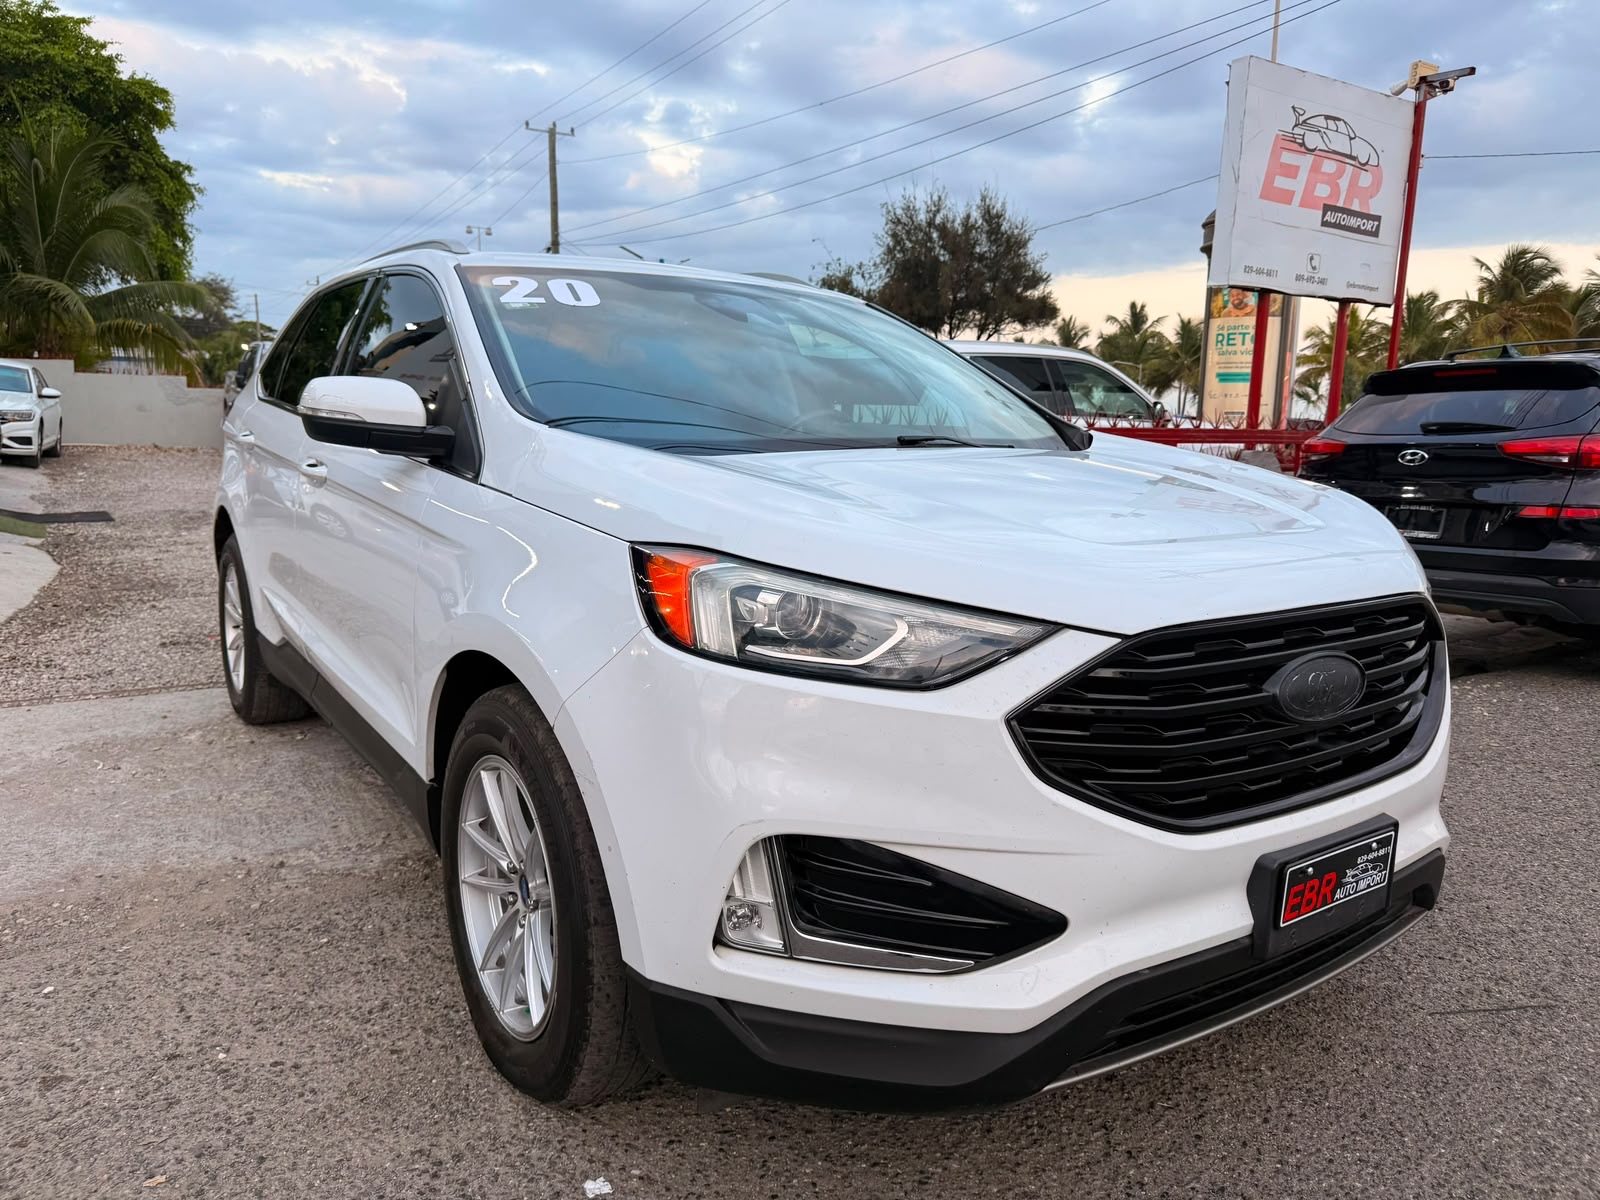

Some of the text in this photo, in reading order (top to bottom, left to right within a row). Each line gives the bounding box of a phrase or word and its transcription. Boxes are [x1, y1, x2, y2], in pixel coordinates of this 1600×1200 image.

[1259, 133, 1383, 214] EBR
[1323, 211, 1379, 232] AUTOIMPORT
[491, 276, 601, 307] 20
[1227, 324, 1250, 332] parte
[1283, 872, 1337, 922] EBR
[1334, 871, 1387, 901] AUTO IMPORT
